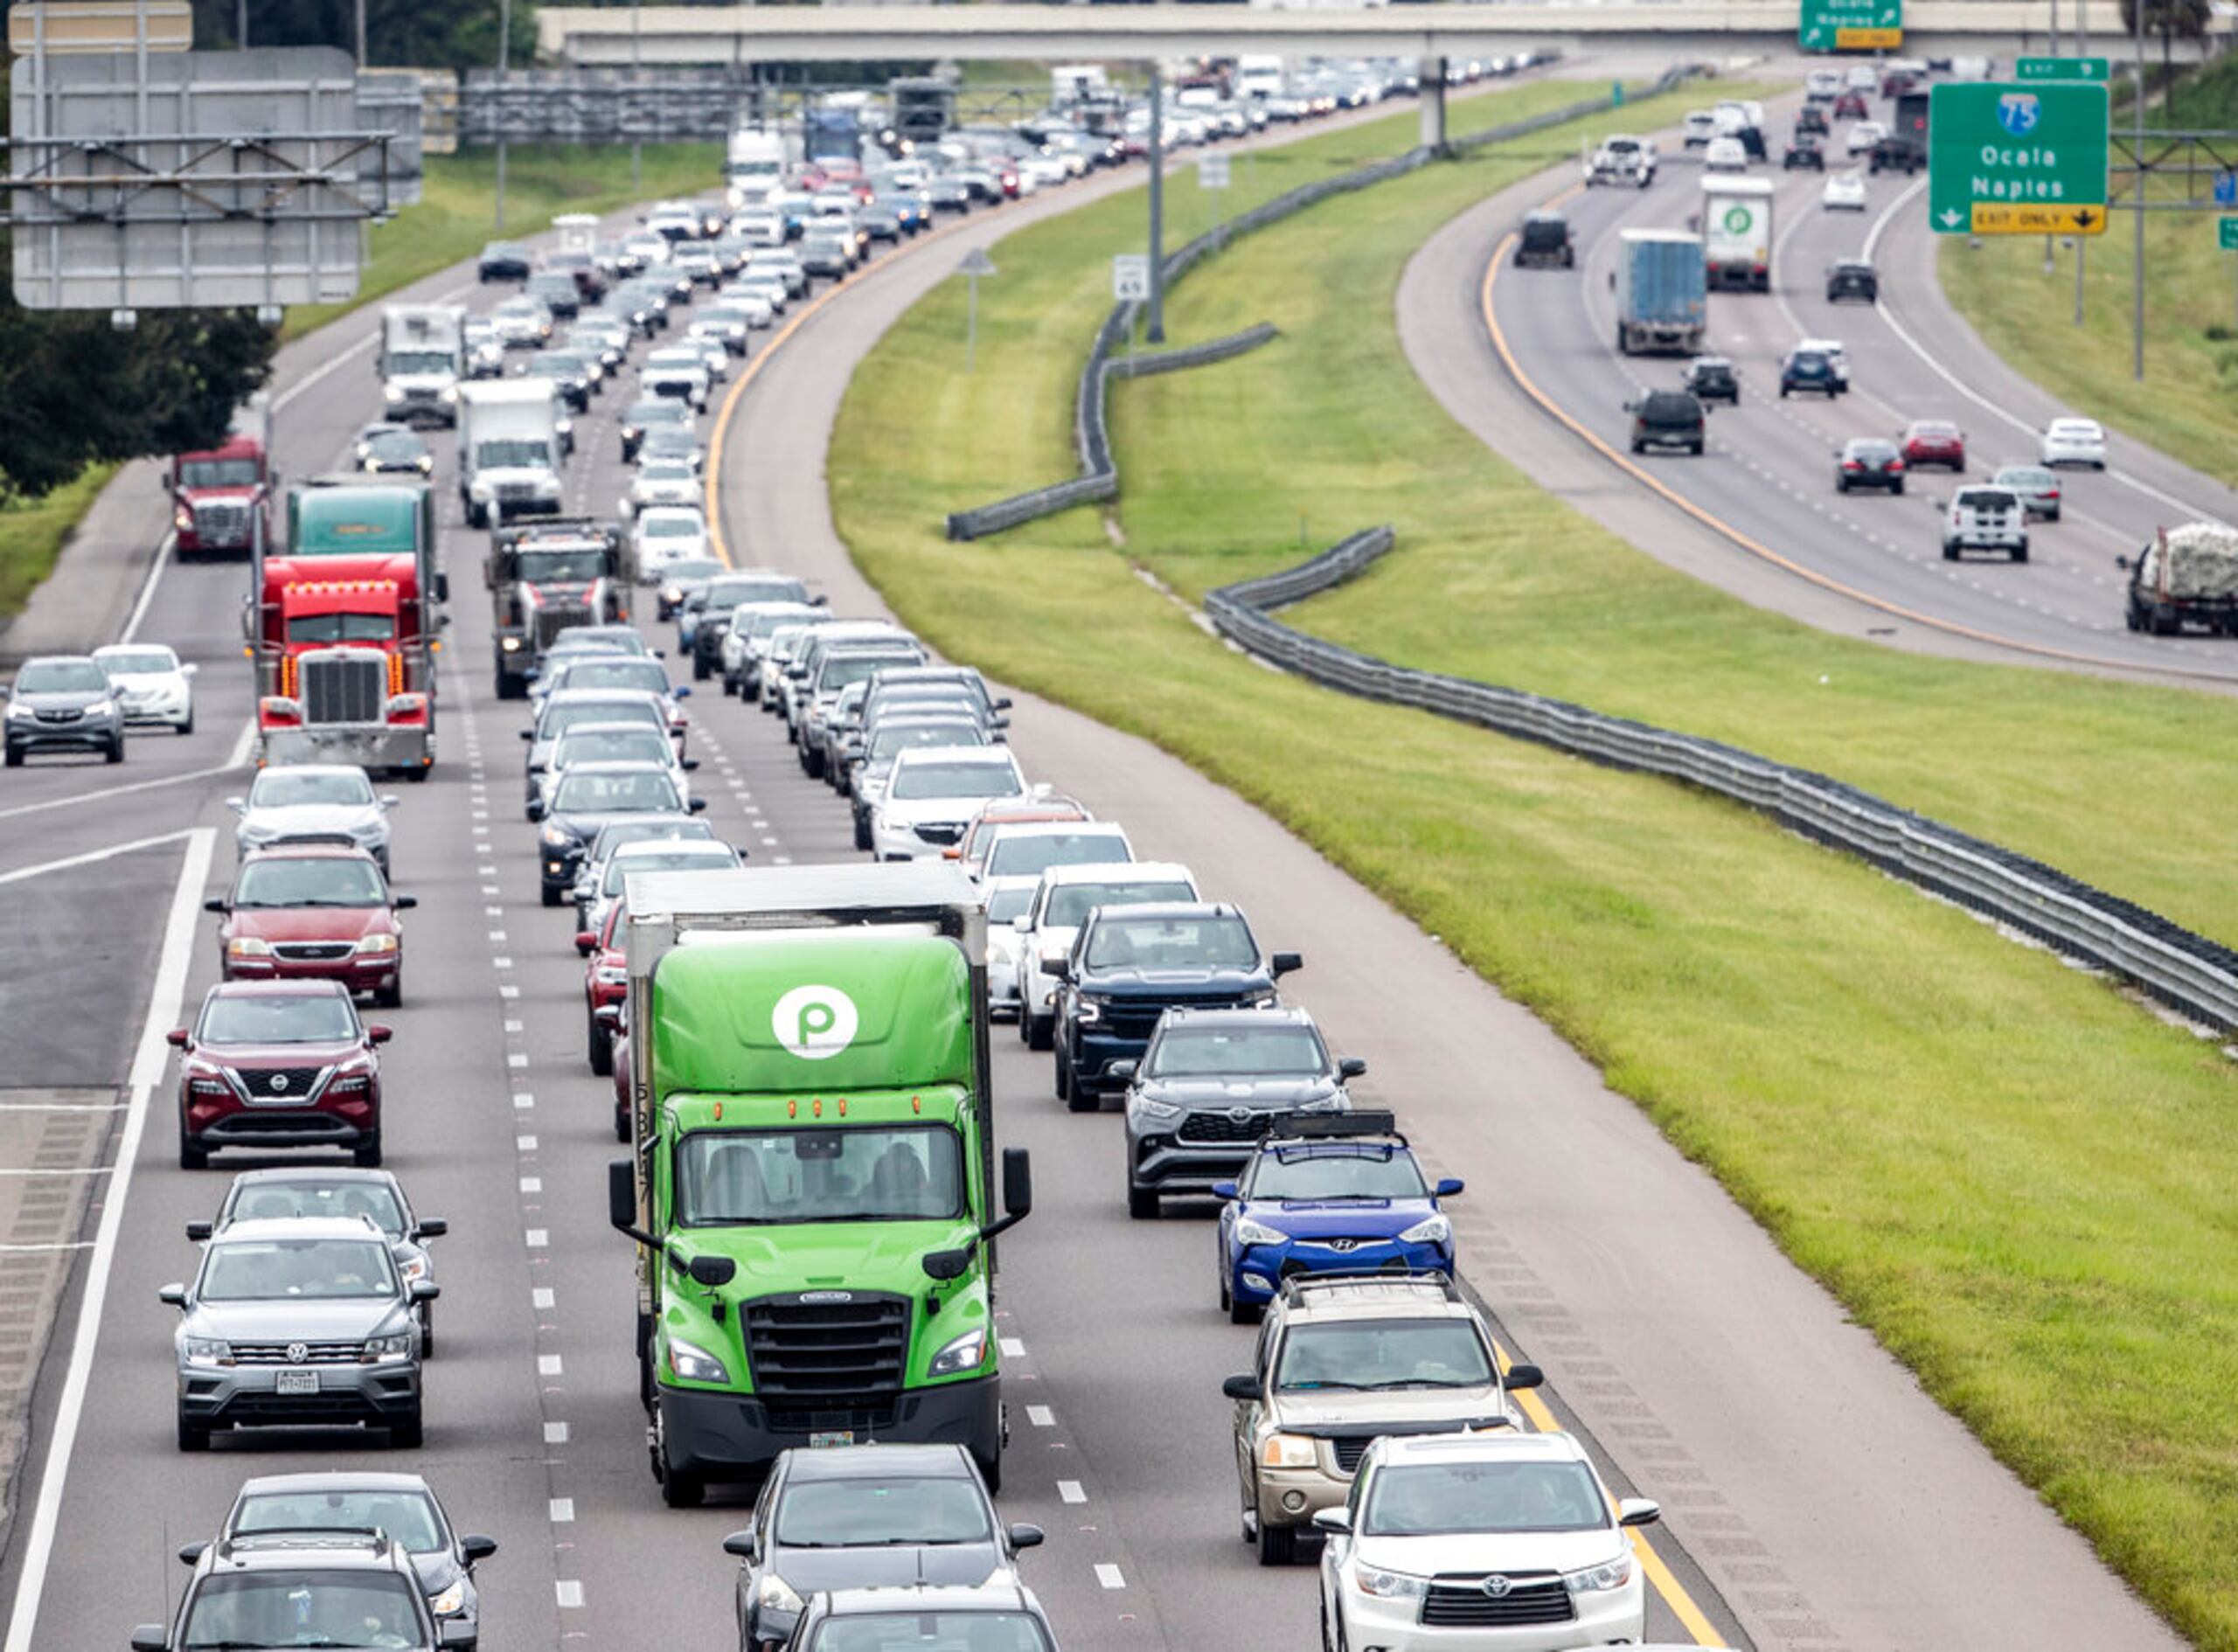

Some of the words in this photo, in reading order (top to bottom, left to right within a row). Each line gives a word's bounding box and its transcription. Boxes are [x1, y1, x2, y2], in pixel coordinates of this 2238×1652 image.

[2005, 103, 2037, 128] 75
[1981, 145, 2056, 166] Ocala
[1972, 176, 2064, 201] Naples
[1977, 212, 2011, 225] EXIT
[2019, 213, 2061, 226] ONLY
